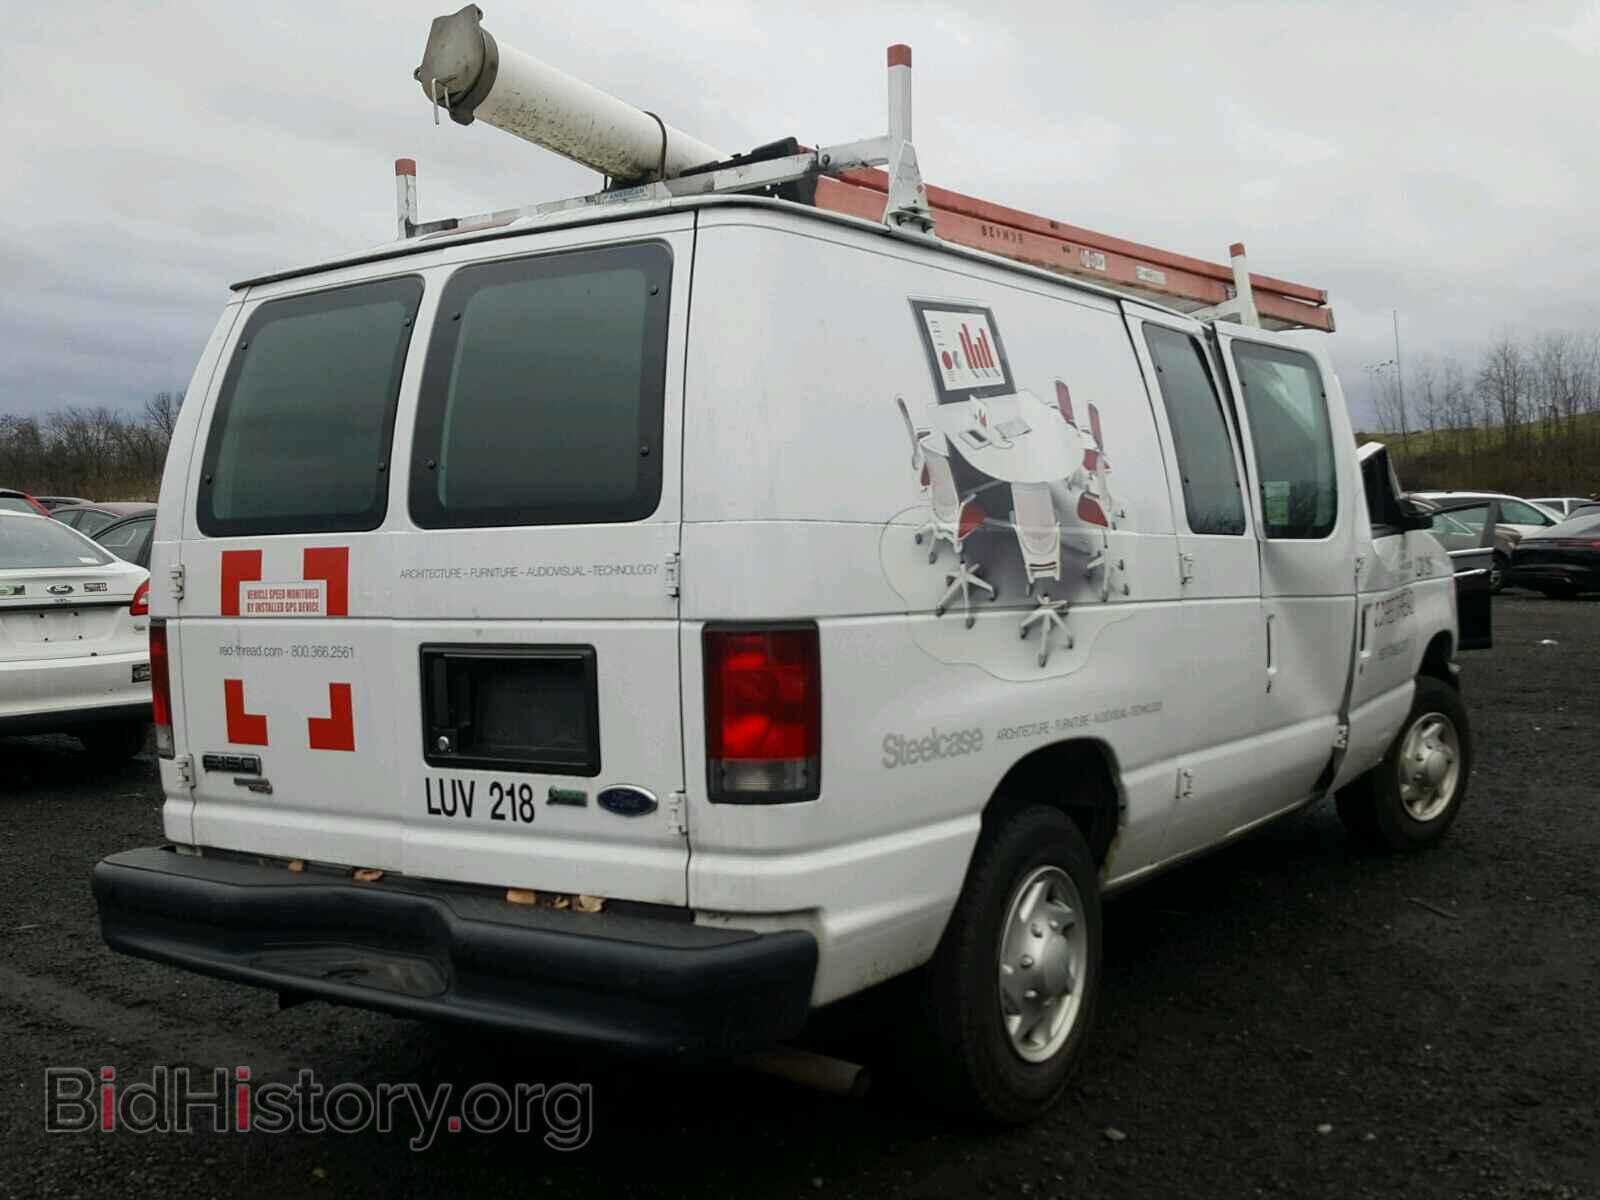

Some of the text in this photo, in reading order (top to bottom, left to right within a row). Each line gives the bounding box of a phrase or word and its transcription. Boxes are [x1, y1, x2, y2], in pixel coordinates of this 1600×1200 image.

[399, 567, 462, 580] ARCHITECTURE
[470, 566, 519, 579] FURNITURE
[527, 565, 585, 578] AUDIOVISUAL
[593, 564, 658, 577] TECHNOLOGY
[247, 588, 320, 600] VEHICLE SPEED MONITORED
[247, 602, 320, 613] BY INSTALLED GPS DEVICE
[219, 644, 284, 658] red-thread.com
[881, 726, 985, 770] Steelcase
[425, 777, 476, 818] LUV
[489, 781, 535, 823] 218
